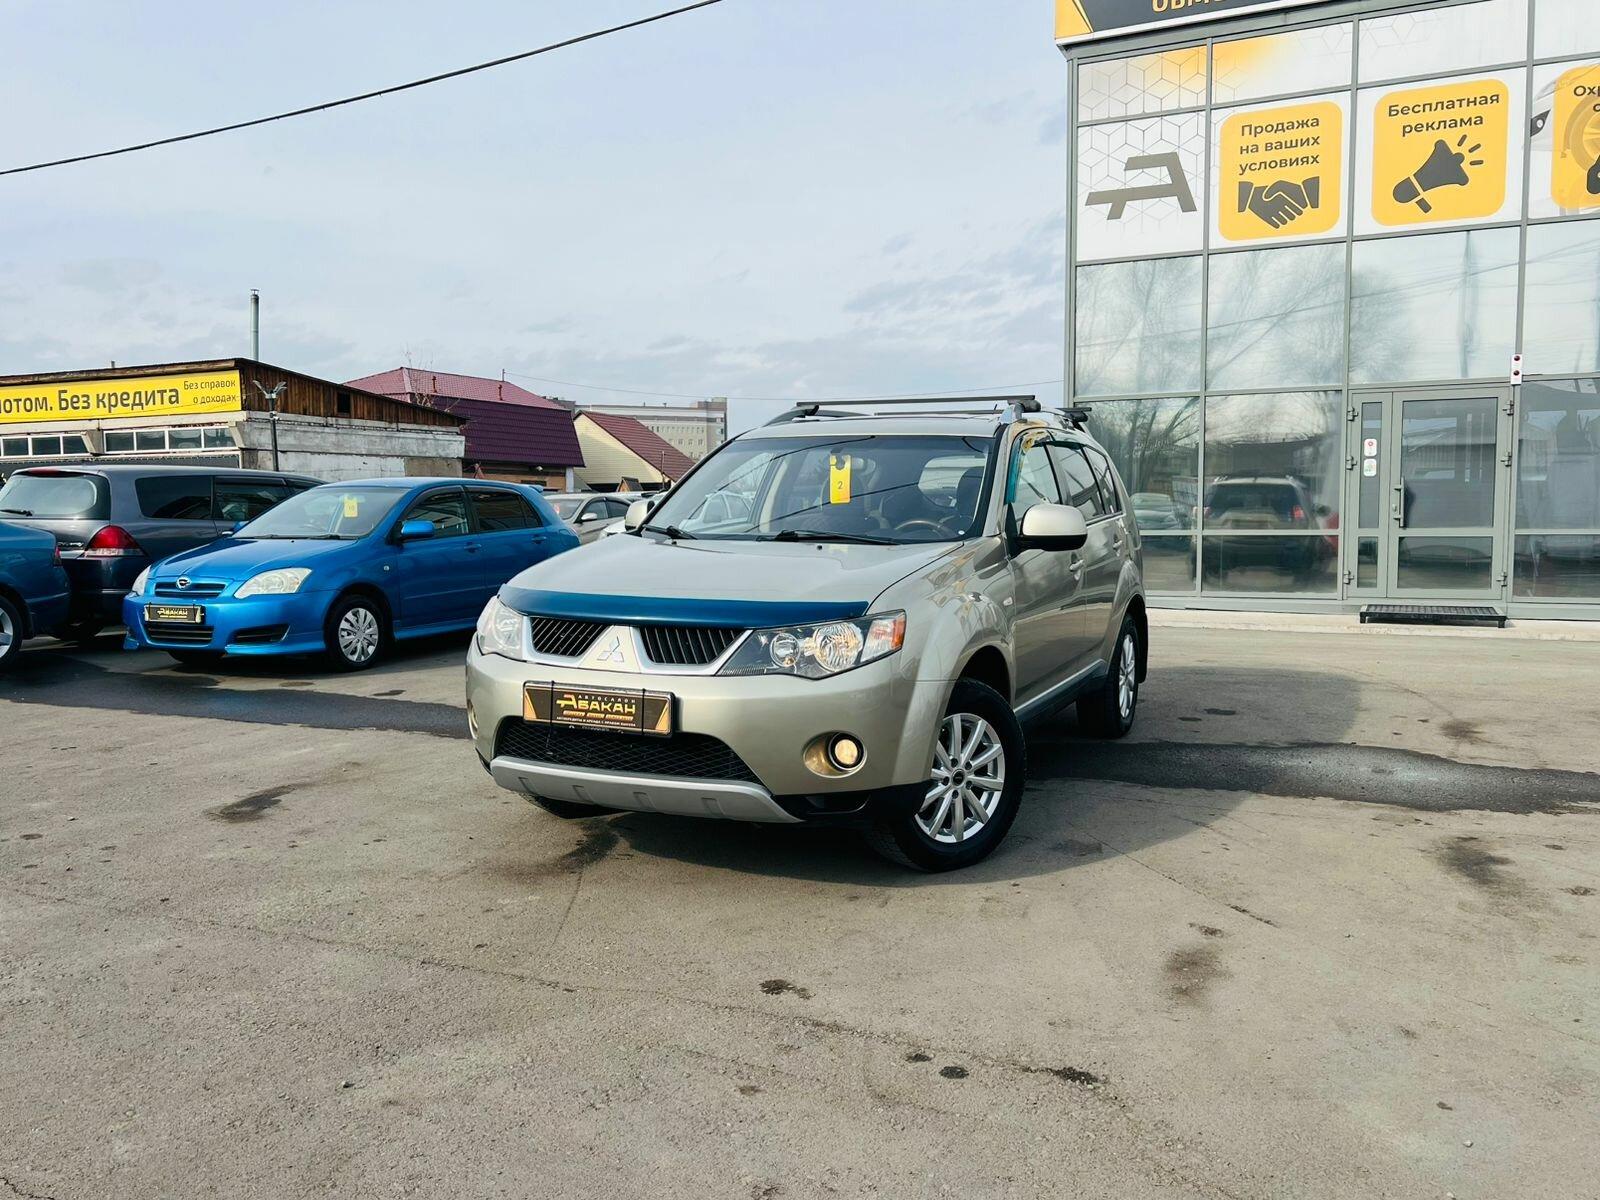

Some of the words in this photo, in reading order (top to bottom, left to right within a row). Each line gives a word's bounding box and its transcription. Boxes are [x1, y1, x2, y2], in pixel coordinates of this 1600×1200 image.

[1388, 94, 1500, 117] Бесплатная
[1241, 117, 1320, 138] Продажа
[1402, 115, 1484, 137] реклама
[1240, 143, 1259, 155] на
[1264, 135, 1320, 152] ваших
[1239, 154, 1320, 176] условиях
[183, 380, 199, 390] Без
[200, 379, 236, 390] справок
[0, 396, 53, 414] отом.
[58, 389, 91, 411] Без
[96, 388, 180, 413] кредита
[193, 396, 199, 404] о
[200, 394, 237, 405] доходах
